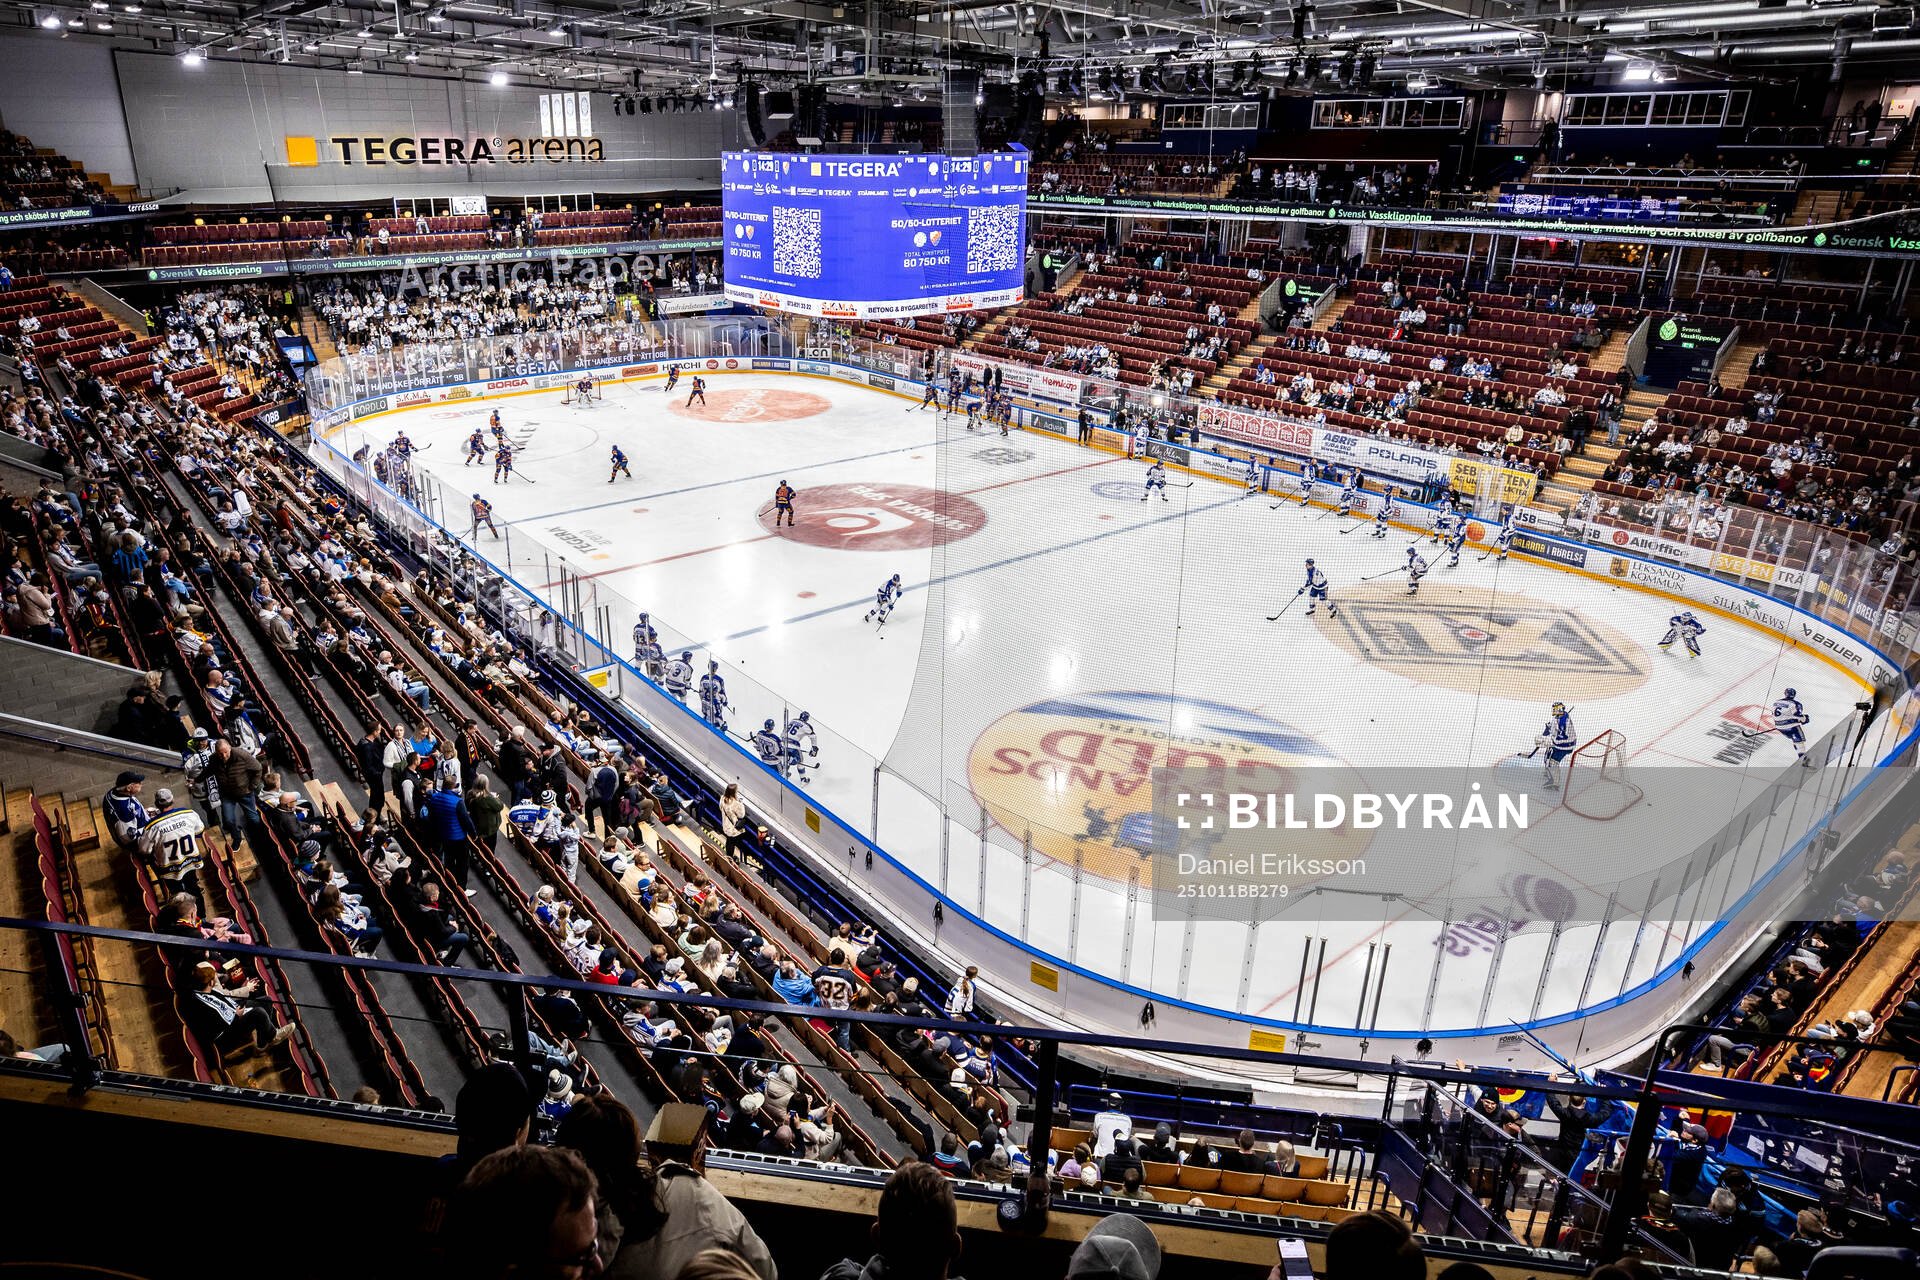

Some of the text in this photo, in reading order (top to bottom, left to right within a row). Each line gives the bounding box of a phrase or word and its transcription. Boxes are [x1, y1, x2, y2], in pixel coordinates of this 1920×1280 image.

[507, 137, 606, 164] arena
[1045, 194, 1064, 202] Svensk
[1065, 195, 1105, 206] Vassklippning
[10, 211, 23, 222] och
[25, 210, 49, 220] skötsel
[50, 211, 59, 219] av
[59, 208, 90, 220] golfbanor
[1209, 203, 1241, 213] muddring
[1241, 205, 1254, 213] och
[1254, 205, 1280, 215] skötsel
[1280, 207, 1289, 215] av
[1290, 207, 1325, 217] golfbanor
[1337, 208, 1432, 224] Svensk Vassklippning
[890, 216, 963, 229] 50/50-LOTTERIET
[1728, 231, 1744, 241] av
[1746, 230, 1808, 245] golfbanor
[1830, 233, 1884, 248] Svensk
[559, 244, 607, 256] Vassklippning
[274, 262, 331, 273] vasklippning,
[405, 255, 440, 266] muddring
[455, 252, 481, 261] skötsel
[491, 250, 523, 260] golfbanor
[903, 255, 950, 268] 80 750 KR
[160, 264, 262, 279] Svensk Vassklippning
[396, 249, 674, 300] Arctic Paper
[868, 305, 894, 314] BETONG
[895, 304, 900, 312] &
[900, 302, 939, 313] BYGGARBETEN
[1680, 332, 1721, 344] Vassklippning
[1681, 326, 1702, 334] Svensk
[494, 360, 560, 378] TEGERA
[662, 361, 701, 372] HITACHI
[487, 378, 529, 390] BORGA
[354, 399, 387, 416] NORDLO
[1322, 432, 1358, 447] ABRIS
[1368, 446, 1438, 470] POLARIS
[549, 526, 598, 554] TEGERA
[1512, 537, 1584, 563] DALARNA RÖRELSE
[1632, 561, 1687, 583] LEKSANDS
[1778, 569, 1805, 585] TRÄ
[1629, 570, 1685, 592] KOMMUN
[1712, 595, 1786, 630] SILJAN NEWS
[1812, 632, 1863, 666] BAUER
[1774, 707, 1782, 717] 6
[1099, 721, 1255, 755] ALKOHOLFRI
[1039, 728, 1300, 796] GULD
[159, 820, 187, 835] HALLBERG
[163, 833, 194, 861] 70
[822, 980, 845, 999] 32
